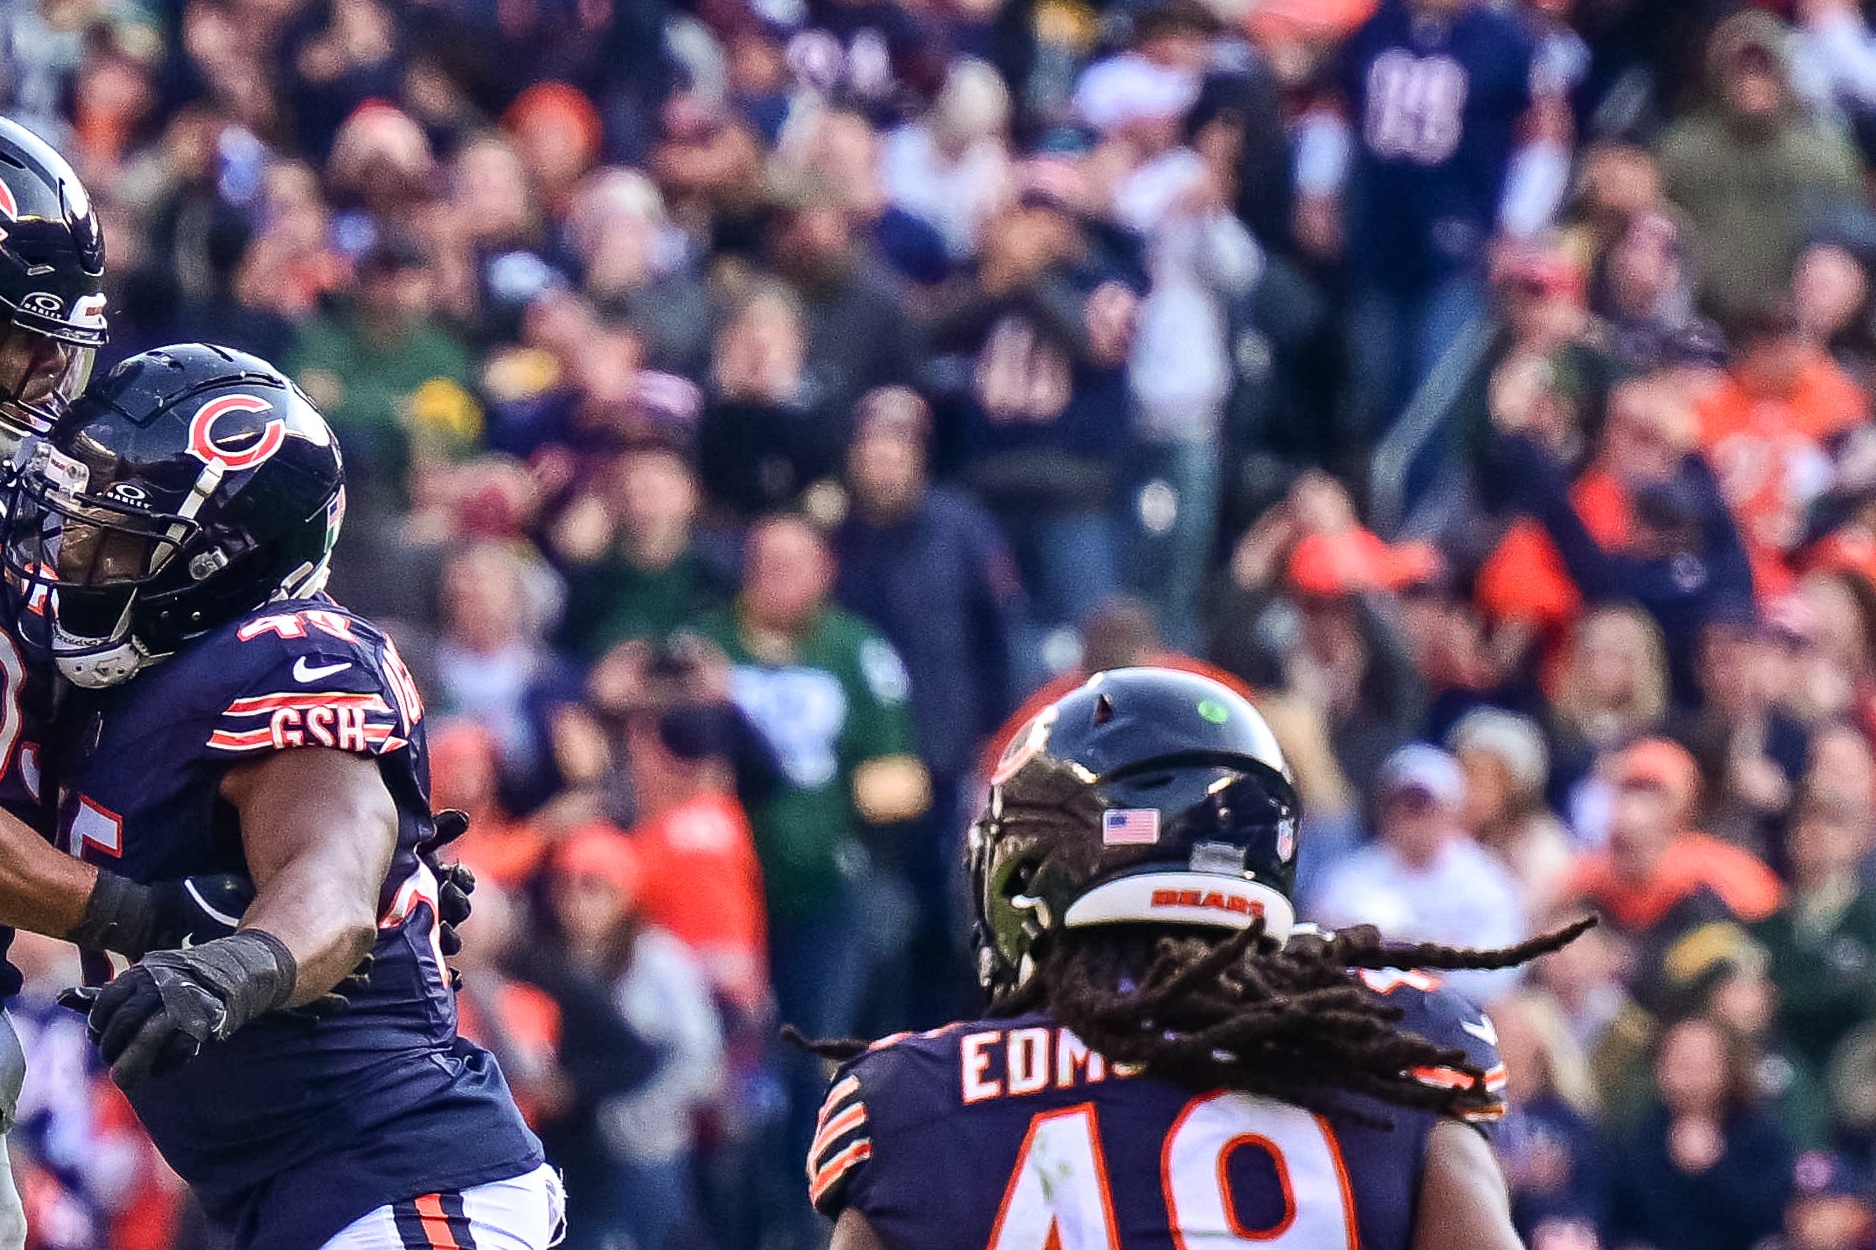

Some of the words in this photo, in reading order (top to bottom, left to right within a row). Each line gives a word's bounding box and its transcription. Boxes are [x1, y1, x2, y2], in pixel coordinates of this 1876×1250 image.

[184, 393, 286, 471] C
[270, 704, 367, 752] GSH
[960, 1027, 1148, 1107] EDM
